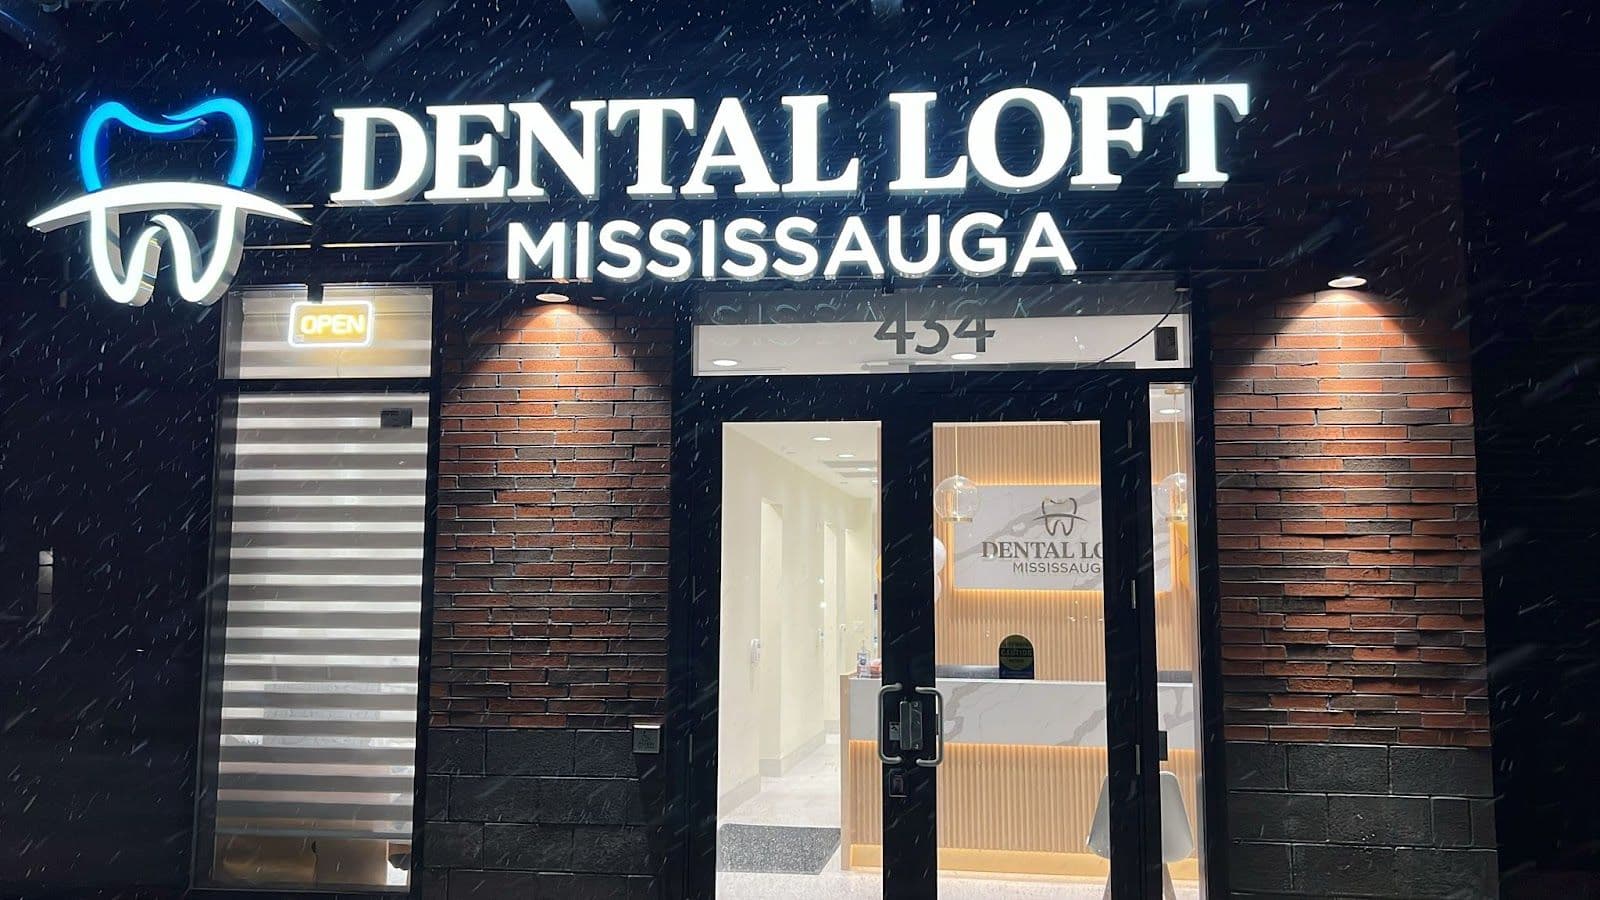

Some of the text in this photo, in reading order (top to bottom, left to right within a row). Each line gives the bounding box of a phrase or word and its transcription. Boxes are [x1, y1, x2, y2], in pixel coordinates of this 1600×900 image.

[330, 83, 1249, 206] DENTAL LOFT
[507, 211, 1078, 282] MISSISSAUGA
[300, 313, 365, 335] OPEN
[873, 311, 996, 355] 434
[981, 541, 1075, 559] DENTAL
